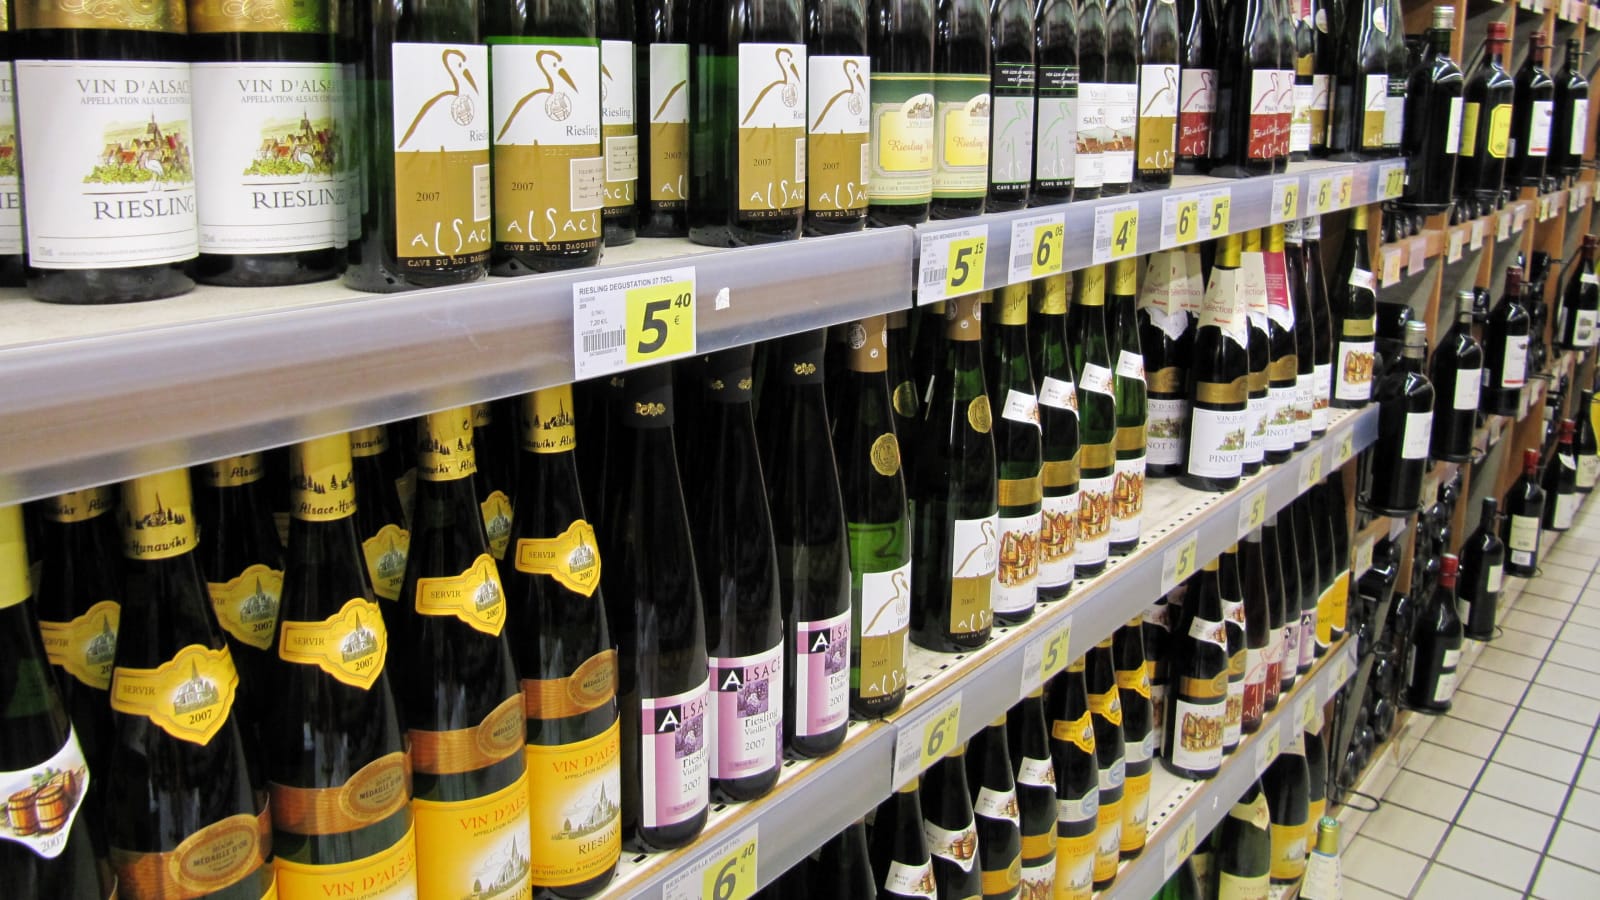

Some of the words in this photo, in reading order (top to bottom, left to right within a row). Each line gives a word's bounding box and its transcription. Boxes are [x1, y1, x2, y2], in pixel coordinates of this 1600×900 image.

[77, 80, 115, 94] VIN
[238, 80, 272, 92] VIN
[602, 108, 631, 120] Riesling
[566, 125, 598, 138] Riesling
[664, 152, 682, 160] 2007
[753, 158, 772, 167] 2007
[822, 162, 840, 170] 2007
[511, 182, 534, 191] 2007
[1340, 182, 1348, 204] 5
[416, 192, 440, 202] 2007
[1318, 184, 1326, 206] 6
[93, 195, 194, 220] RIESLING
[1284, 191, 1292, 216] 9
[1179, 206, 1190, 236] 6
[1212, 202, 1223, 230] 5
[1116, 220, 1129, 251] 4
[1036, 230, 1053, 266] 6
[951, 247, 972, 287] 5
[974, 242, 984, 254] 15
[579, 284, 608, 296] RIESLING
[610, 278, 652, 292] DEGUSTATION
[637, 299, 672, 354] 5
[674, 292, 692, 308] 40
[1208, 454, 1237, 464] PINOT
[1250, 500, 1259, 525] 5
[1178, 548, 1190, 576] 5
[580, 569, 592, 581] 2007
[430, 590, 462, 598] SERVIR
[486, 608, 500, 619] 2007
[252, 620, 273, 632] 2007
[292, 636, 326, 646] SERVIR
[1044, 637, 1060, 672] 5
[354, 658, 374, 671] 2007
[872, 658, 888, 668] 2007
[720, 657, 782, 691] ALSACE
[122, 684, 156, 696] SERVIR
[830, 693, 844, 706] 2007
[189, 709, 212, 724] 2007
[744, 738, 765, 751] 2007
[928, 717, 946, 757] 6
[552, 758, 578, 774] VIN
[682, 777, 701, 793] 2007
[460, 814, 489, 831] VIN
[40, 834, 65, 852] 2007
[712, 856, 738, 900] 6
[742, 843, 755, 859] 40
[322, 881, 354, 897] VIN
